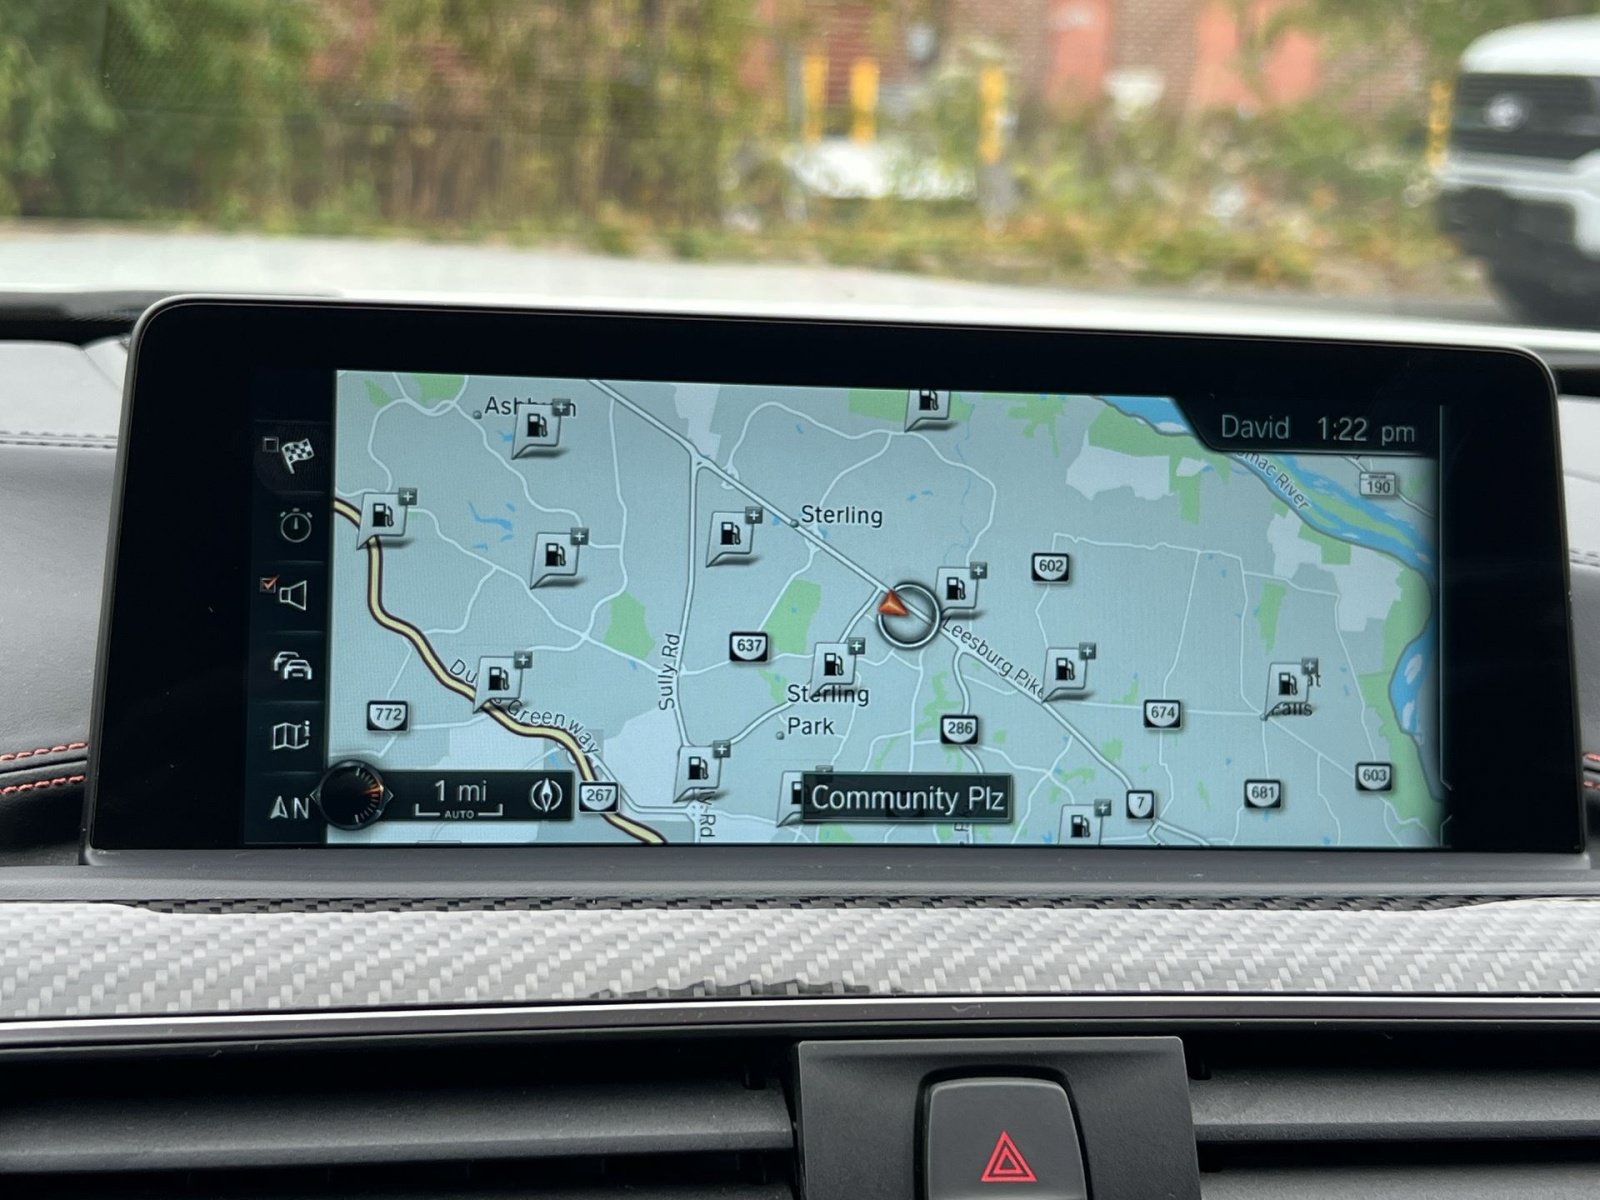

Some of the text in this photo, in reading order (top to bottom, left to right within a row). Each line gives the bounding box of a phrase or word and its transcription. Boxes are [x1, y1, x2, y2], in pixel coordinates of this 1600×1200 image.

[485, 396, 576, 417] Ashn
[1221, 415, 1415, 447] David 1:22 pm
[1275, 473, 1311, 509] River
[1367, 480, 1391, 494] 190
[801, 505, 883, 528] Sterling
[1038, 558, 1064, 574] 602
[737, 639, 762, 654] 637
[942, 616, 1044, 699] Leesburg Pike
[658, 633, 680, 710] Sully Rd
[787, 684, 869, 707] Sterling
[375, 708, 402, 722] 772
[1150, 705, 1175, 720] 674
[507, 699, 599, 754] Greenway
[787, 717, 834, 735] Park
[947, 721, 973, 736] 286
[1362, 769, 1387, 784] 603
[434, 780, 488, 801] 1 mi
[586, 788, 613, 803] 267
[1251, 785, 1276, 800] 681
[294, 799, 309, 819] N
[811, 785, 1004, 816] Community Plz
[1137, 797, 1145, 809] 7
[444, 809, 475, 819] AUTO
[700, 813, 716, 838] Rd
